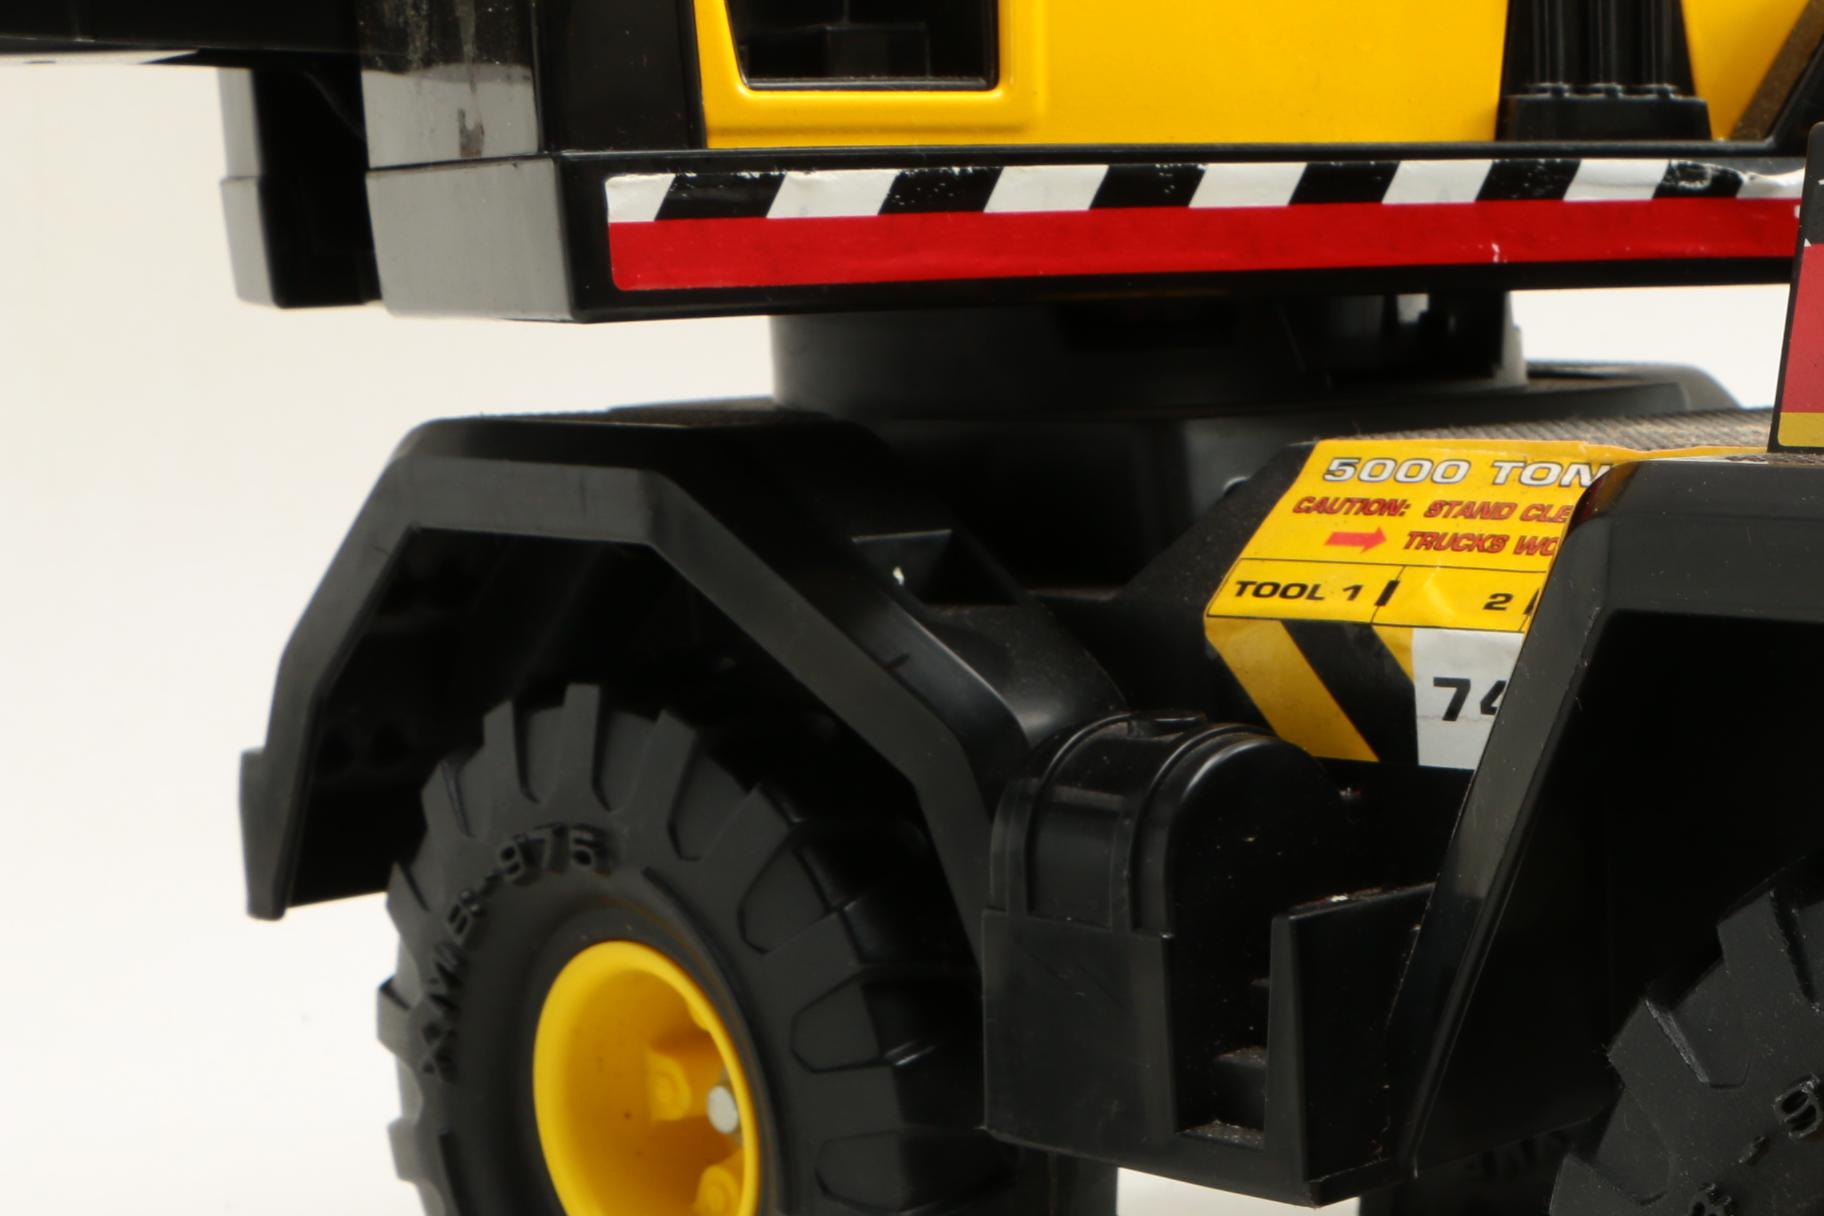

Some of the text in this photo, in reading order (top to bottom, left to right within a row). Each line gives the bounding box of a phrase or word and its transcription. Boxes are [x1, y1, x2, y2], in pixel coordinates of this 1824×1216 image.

[1322, 457, 1472, 485] 5000
[1292, 496, 1411, 517] CAUTION:
[1423, 499, 1516, 521] STAND
[1403, 530, 1511, 554] TRUCKS
[1235, 579, 1514, 612] TOOL 1 2
